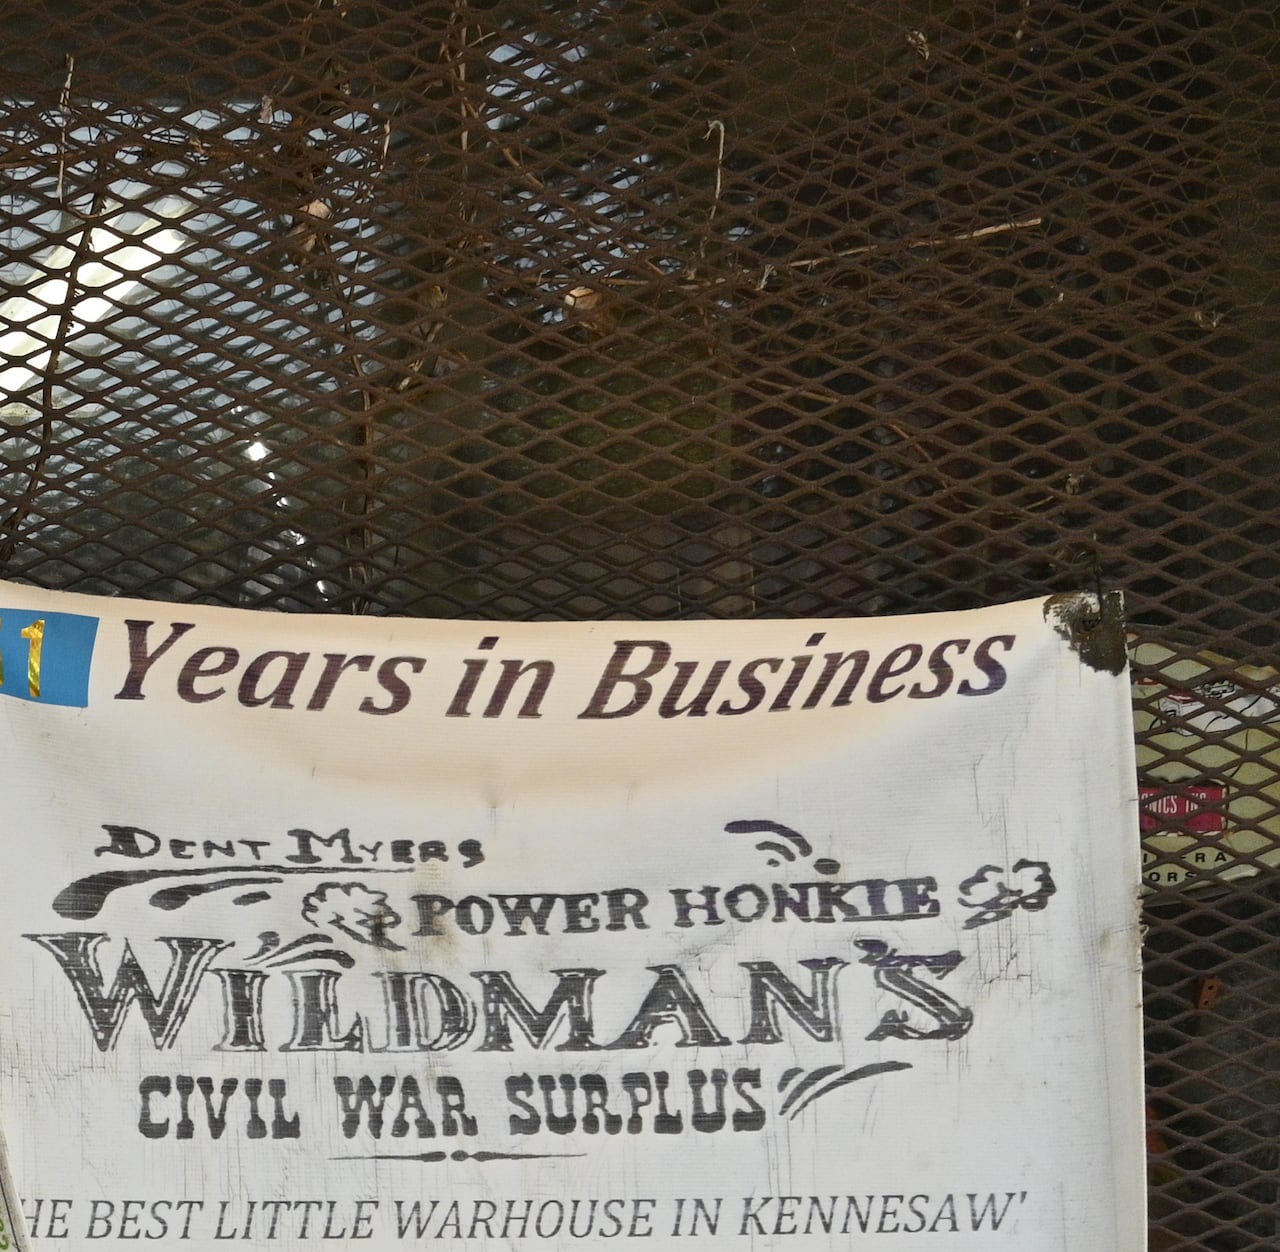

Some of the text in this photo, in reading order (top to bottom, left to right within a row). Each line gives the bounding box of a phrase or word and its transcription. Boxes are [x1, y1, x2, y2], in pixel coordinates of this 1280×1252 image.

[114, 619, 428, 717] Years
[445, 637, 556, 719] in
[577, 632, 1017, 720] Business
[94, 824, 486, 869] DENT MYERS
[410, 875, 940, 937] POWER HONKIE
[21, 932, 975, 1053] WILDMAN'S
[138, 1067, 767, 1140] CIVIL WAR SURPLUS
[18, 1198, 74, 1240] HE
[86, 1198, 204, 1240] BEST
[214, 1198, 381, 1240] LITTLE
[393, 1198, 657, 1240] WARHOUSE
[670, 1197, 723, 1238] IN
